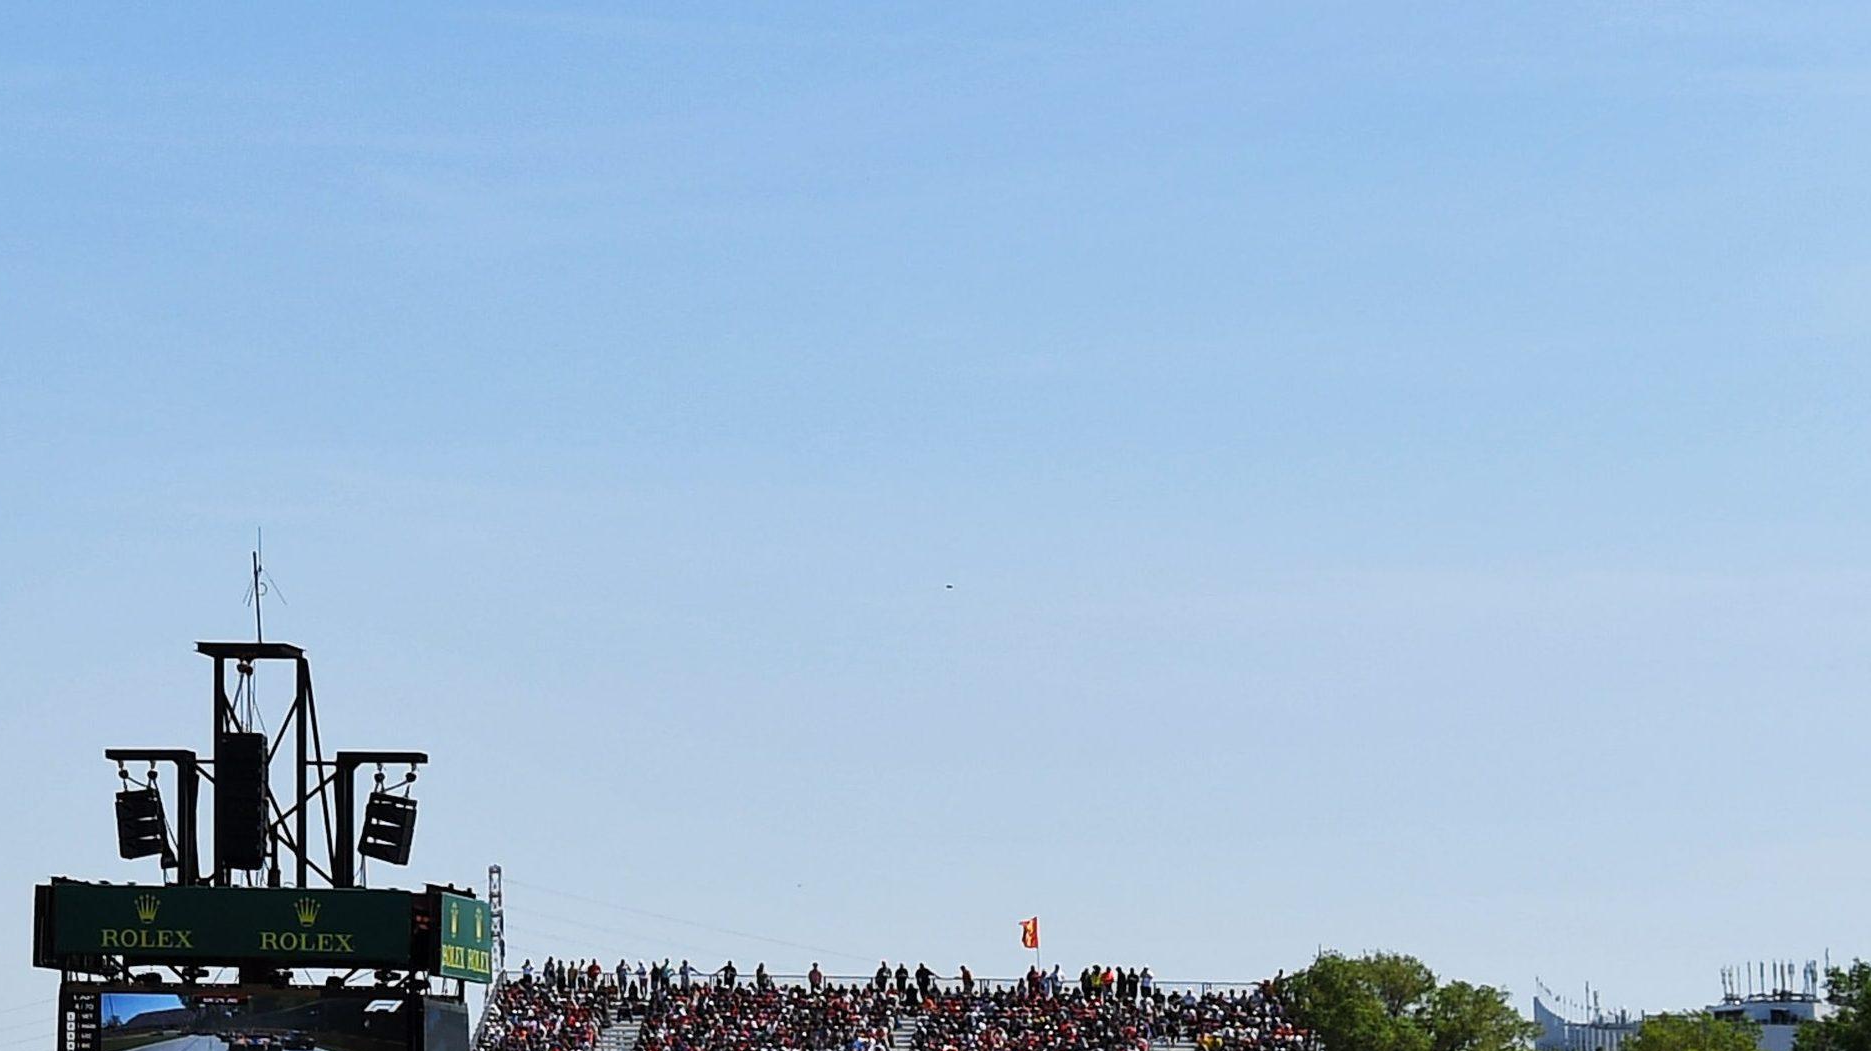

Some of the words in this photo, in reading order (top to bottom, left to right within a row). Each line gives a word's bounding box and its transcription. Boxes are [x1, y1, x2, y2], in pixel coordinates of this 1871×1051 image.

[100, 929, 193, 948] ROLEX
[259, 931, 355, 952] ROLEX
[441, 944, 465, 969] ROLEX
[468, 948, 490, 974] ROLEX
